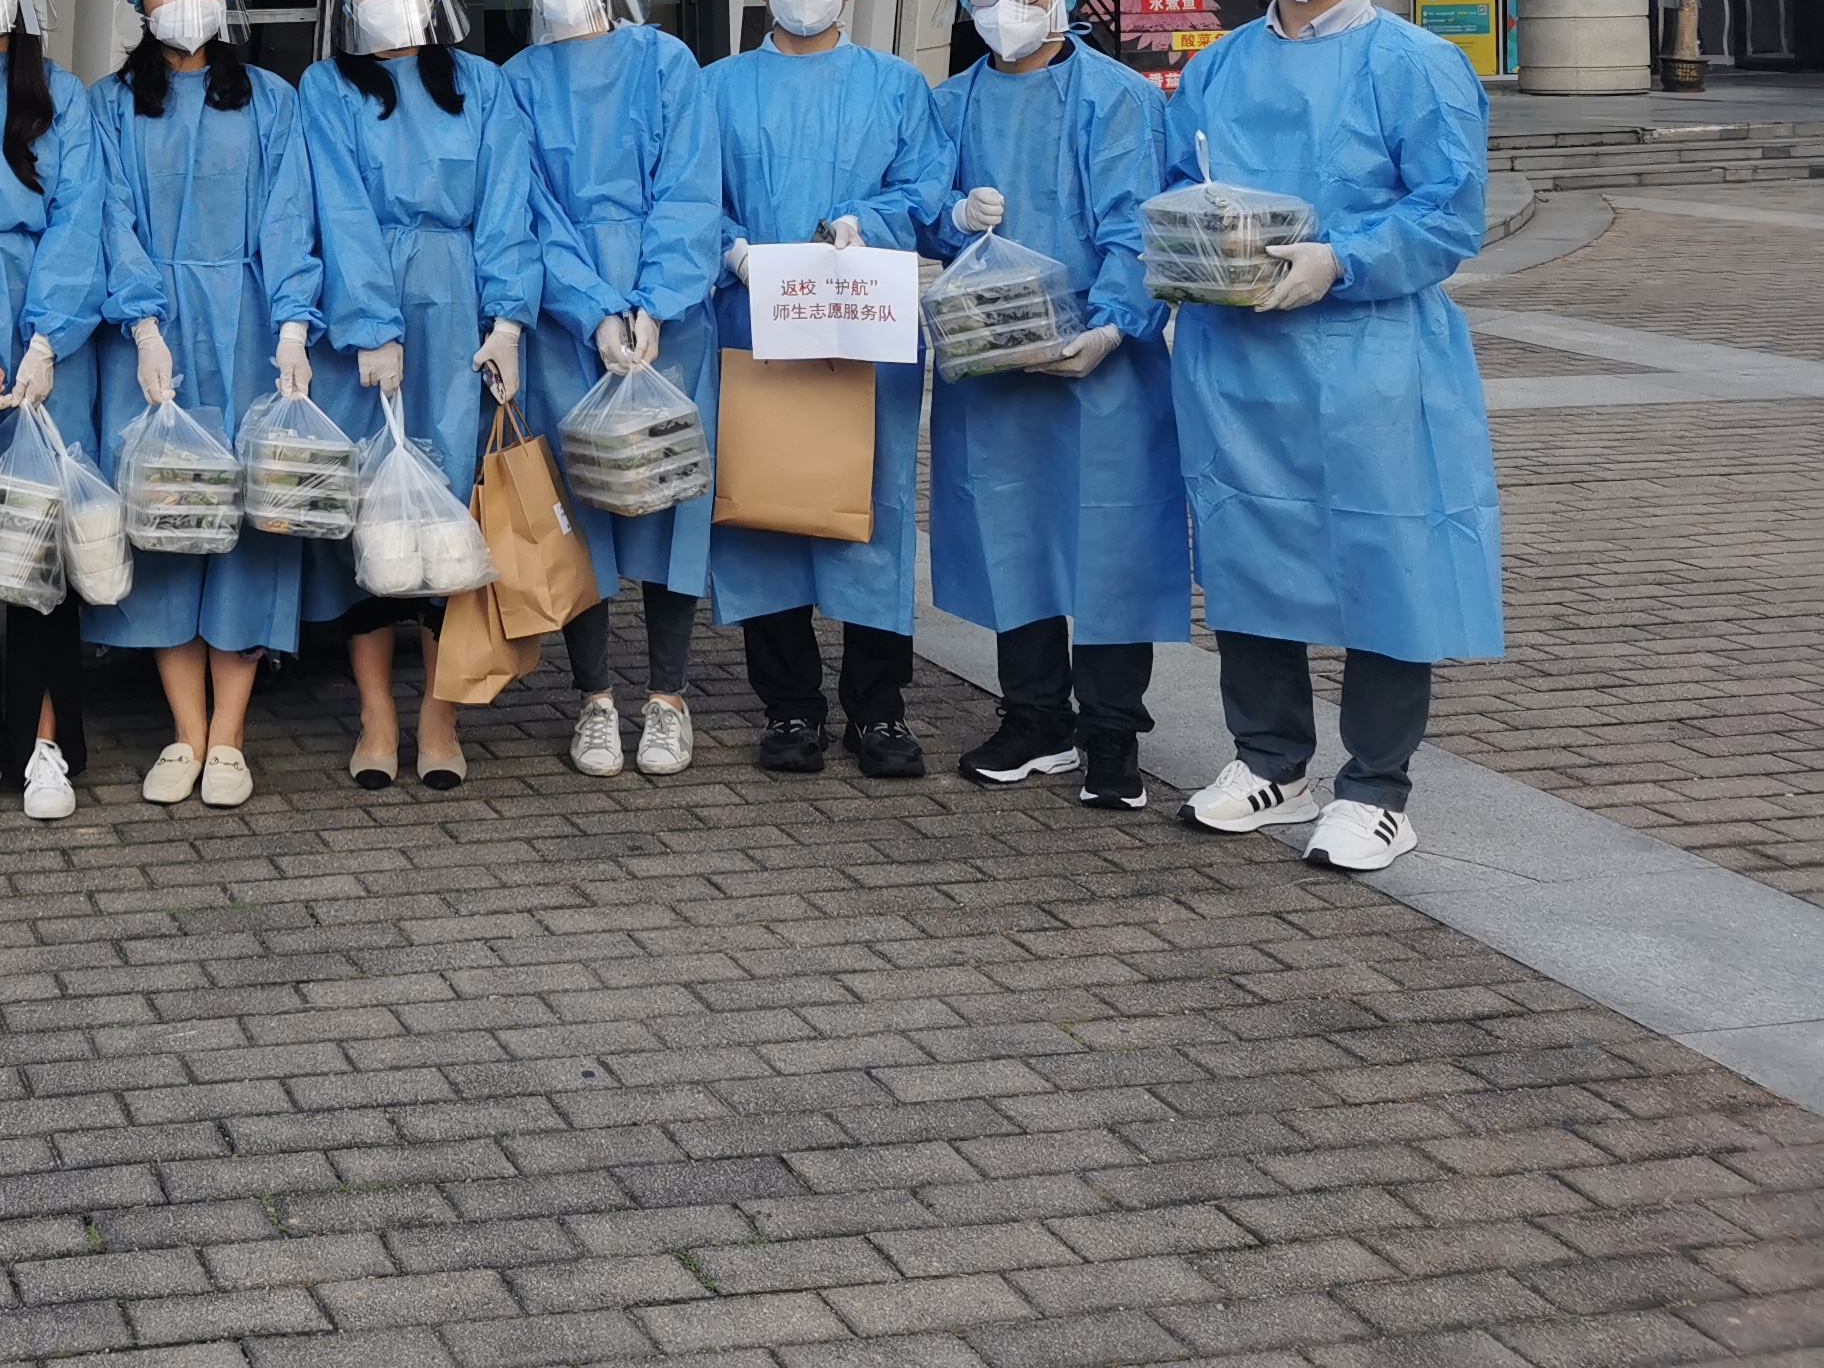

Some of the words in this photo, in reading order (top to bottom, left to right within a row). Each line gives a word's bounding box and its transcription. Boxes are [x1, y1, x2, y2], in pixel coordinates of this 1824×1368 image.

[780, 278, 879, 297] 返校“护航”
[772, 302, 897, 323] 师生志愿服务队
